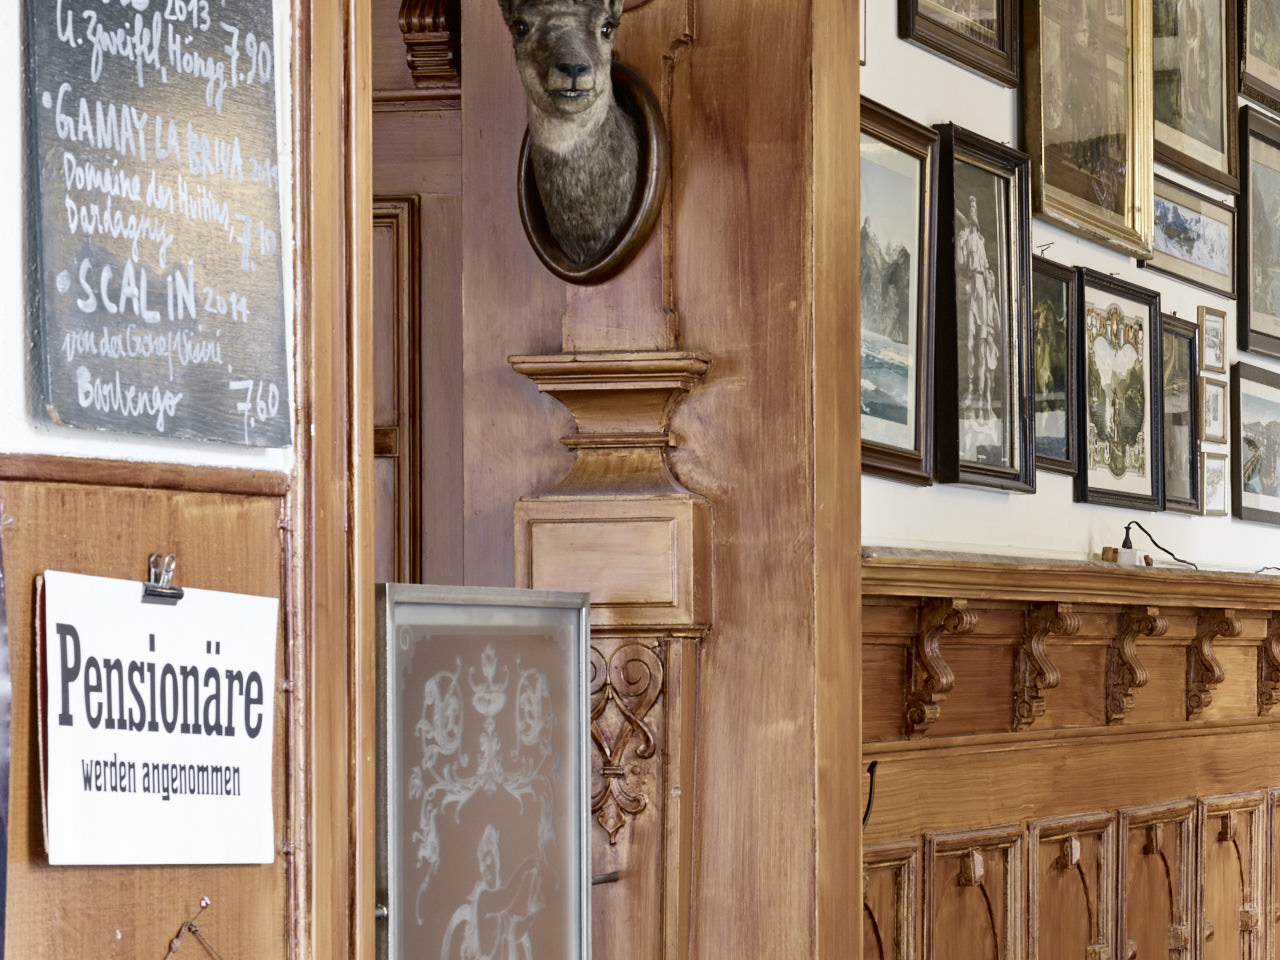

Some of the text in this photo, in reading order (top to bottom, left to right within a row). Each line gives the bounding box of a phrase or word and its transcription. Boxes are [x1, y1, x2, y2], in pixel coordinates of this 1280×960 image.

[219, 21, 272, 87] 7.90
[55, 82, 148, 162] GAMAY
[155, 115, 182, 163] LA
[203, 286, 250, 322] 2014
[228, 380, 280, 444] 7.60
[56, 622, 264, 739] Pensionäre
[81, 753, 241, 801] werden angenommen
